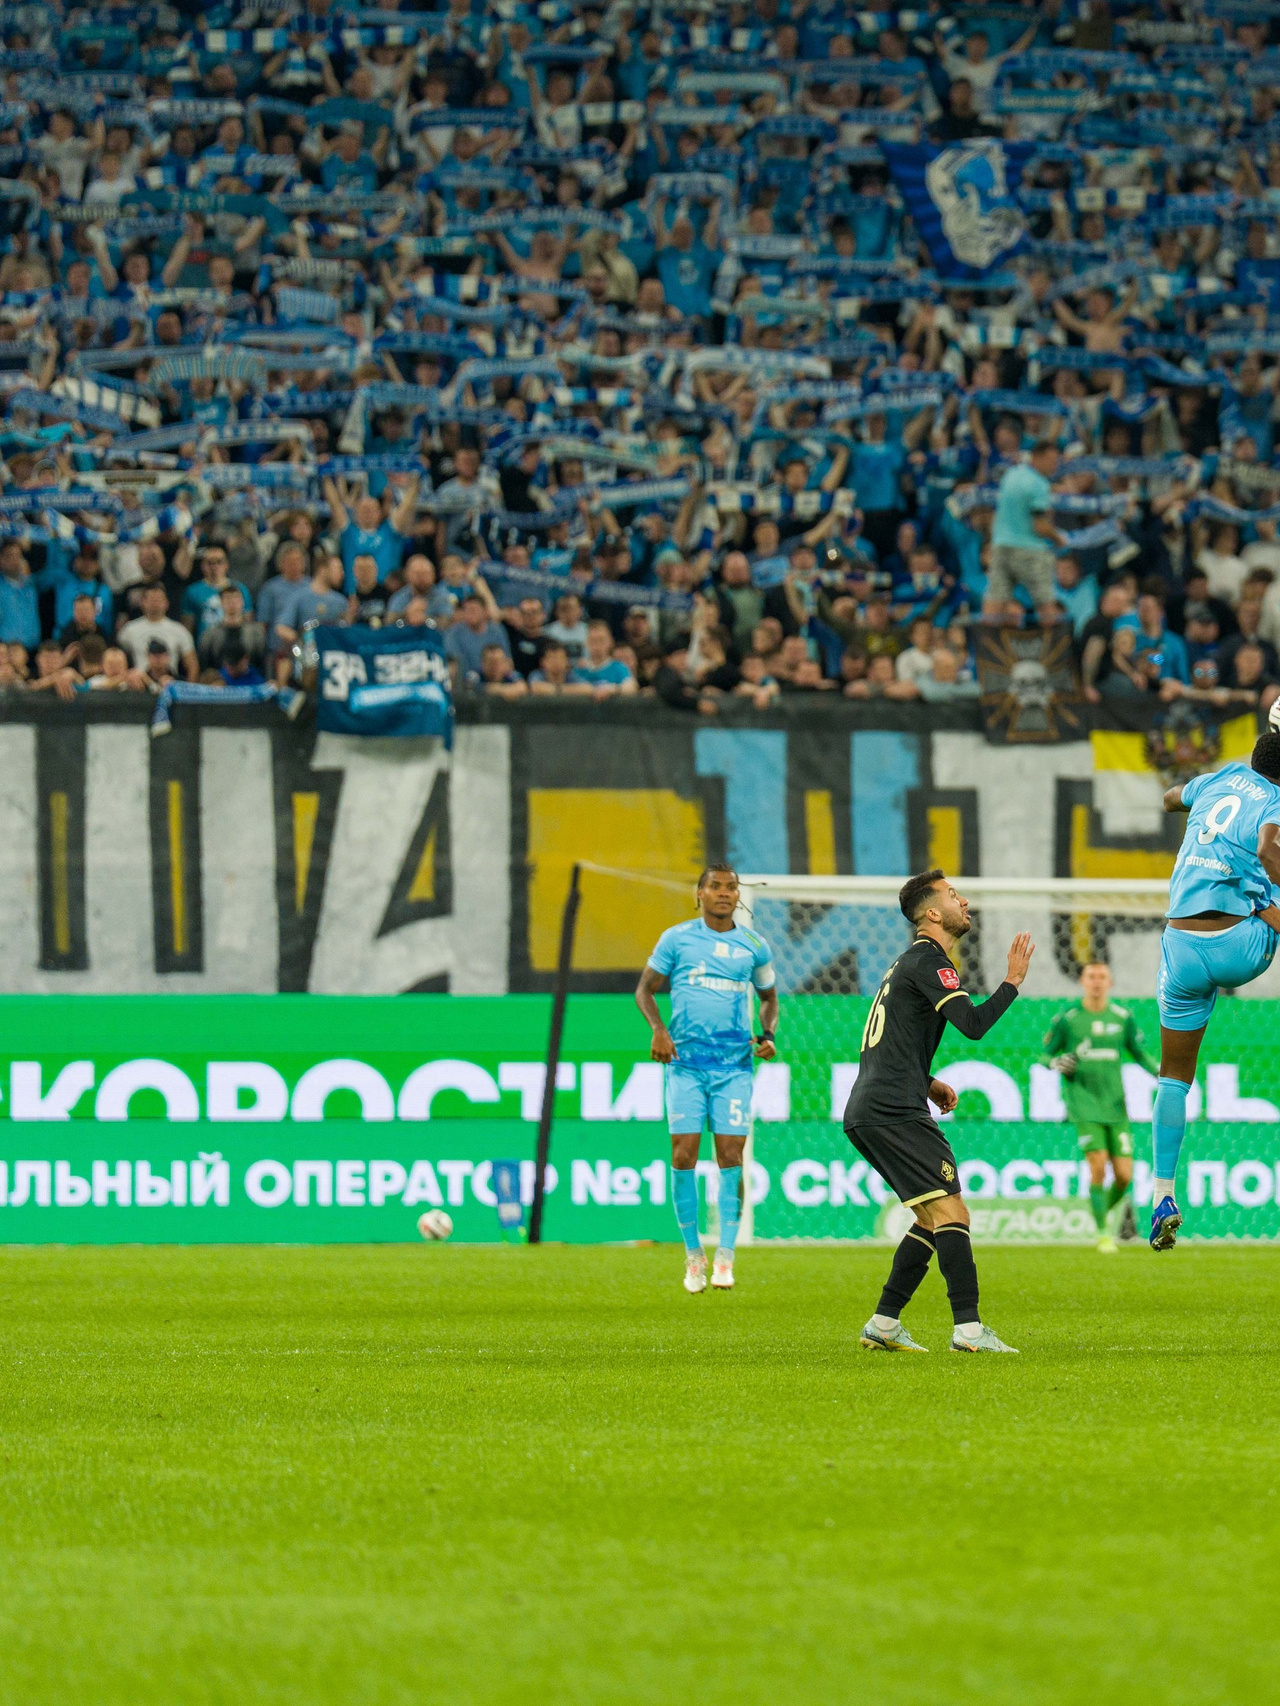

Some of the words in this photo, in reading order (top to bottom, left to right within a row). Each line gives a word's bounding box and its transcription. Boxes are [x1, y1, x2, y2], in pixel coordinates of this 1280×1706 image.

[1226, 774, 1268, 801] ДУРАН
[1197, 794, 1242, 845] 9
[0, 1058, 664, 1121] КОРОСТИ
[728, 1098, 743, 1128] 5
[0, 1151, 230, 1208] ЛЬНЫЙ
[571, 1159, 666, 1207] №1
